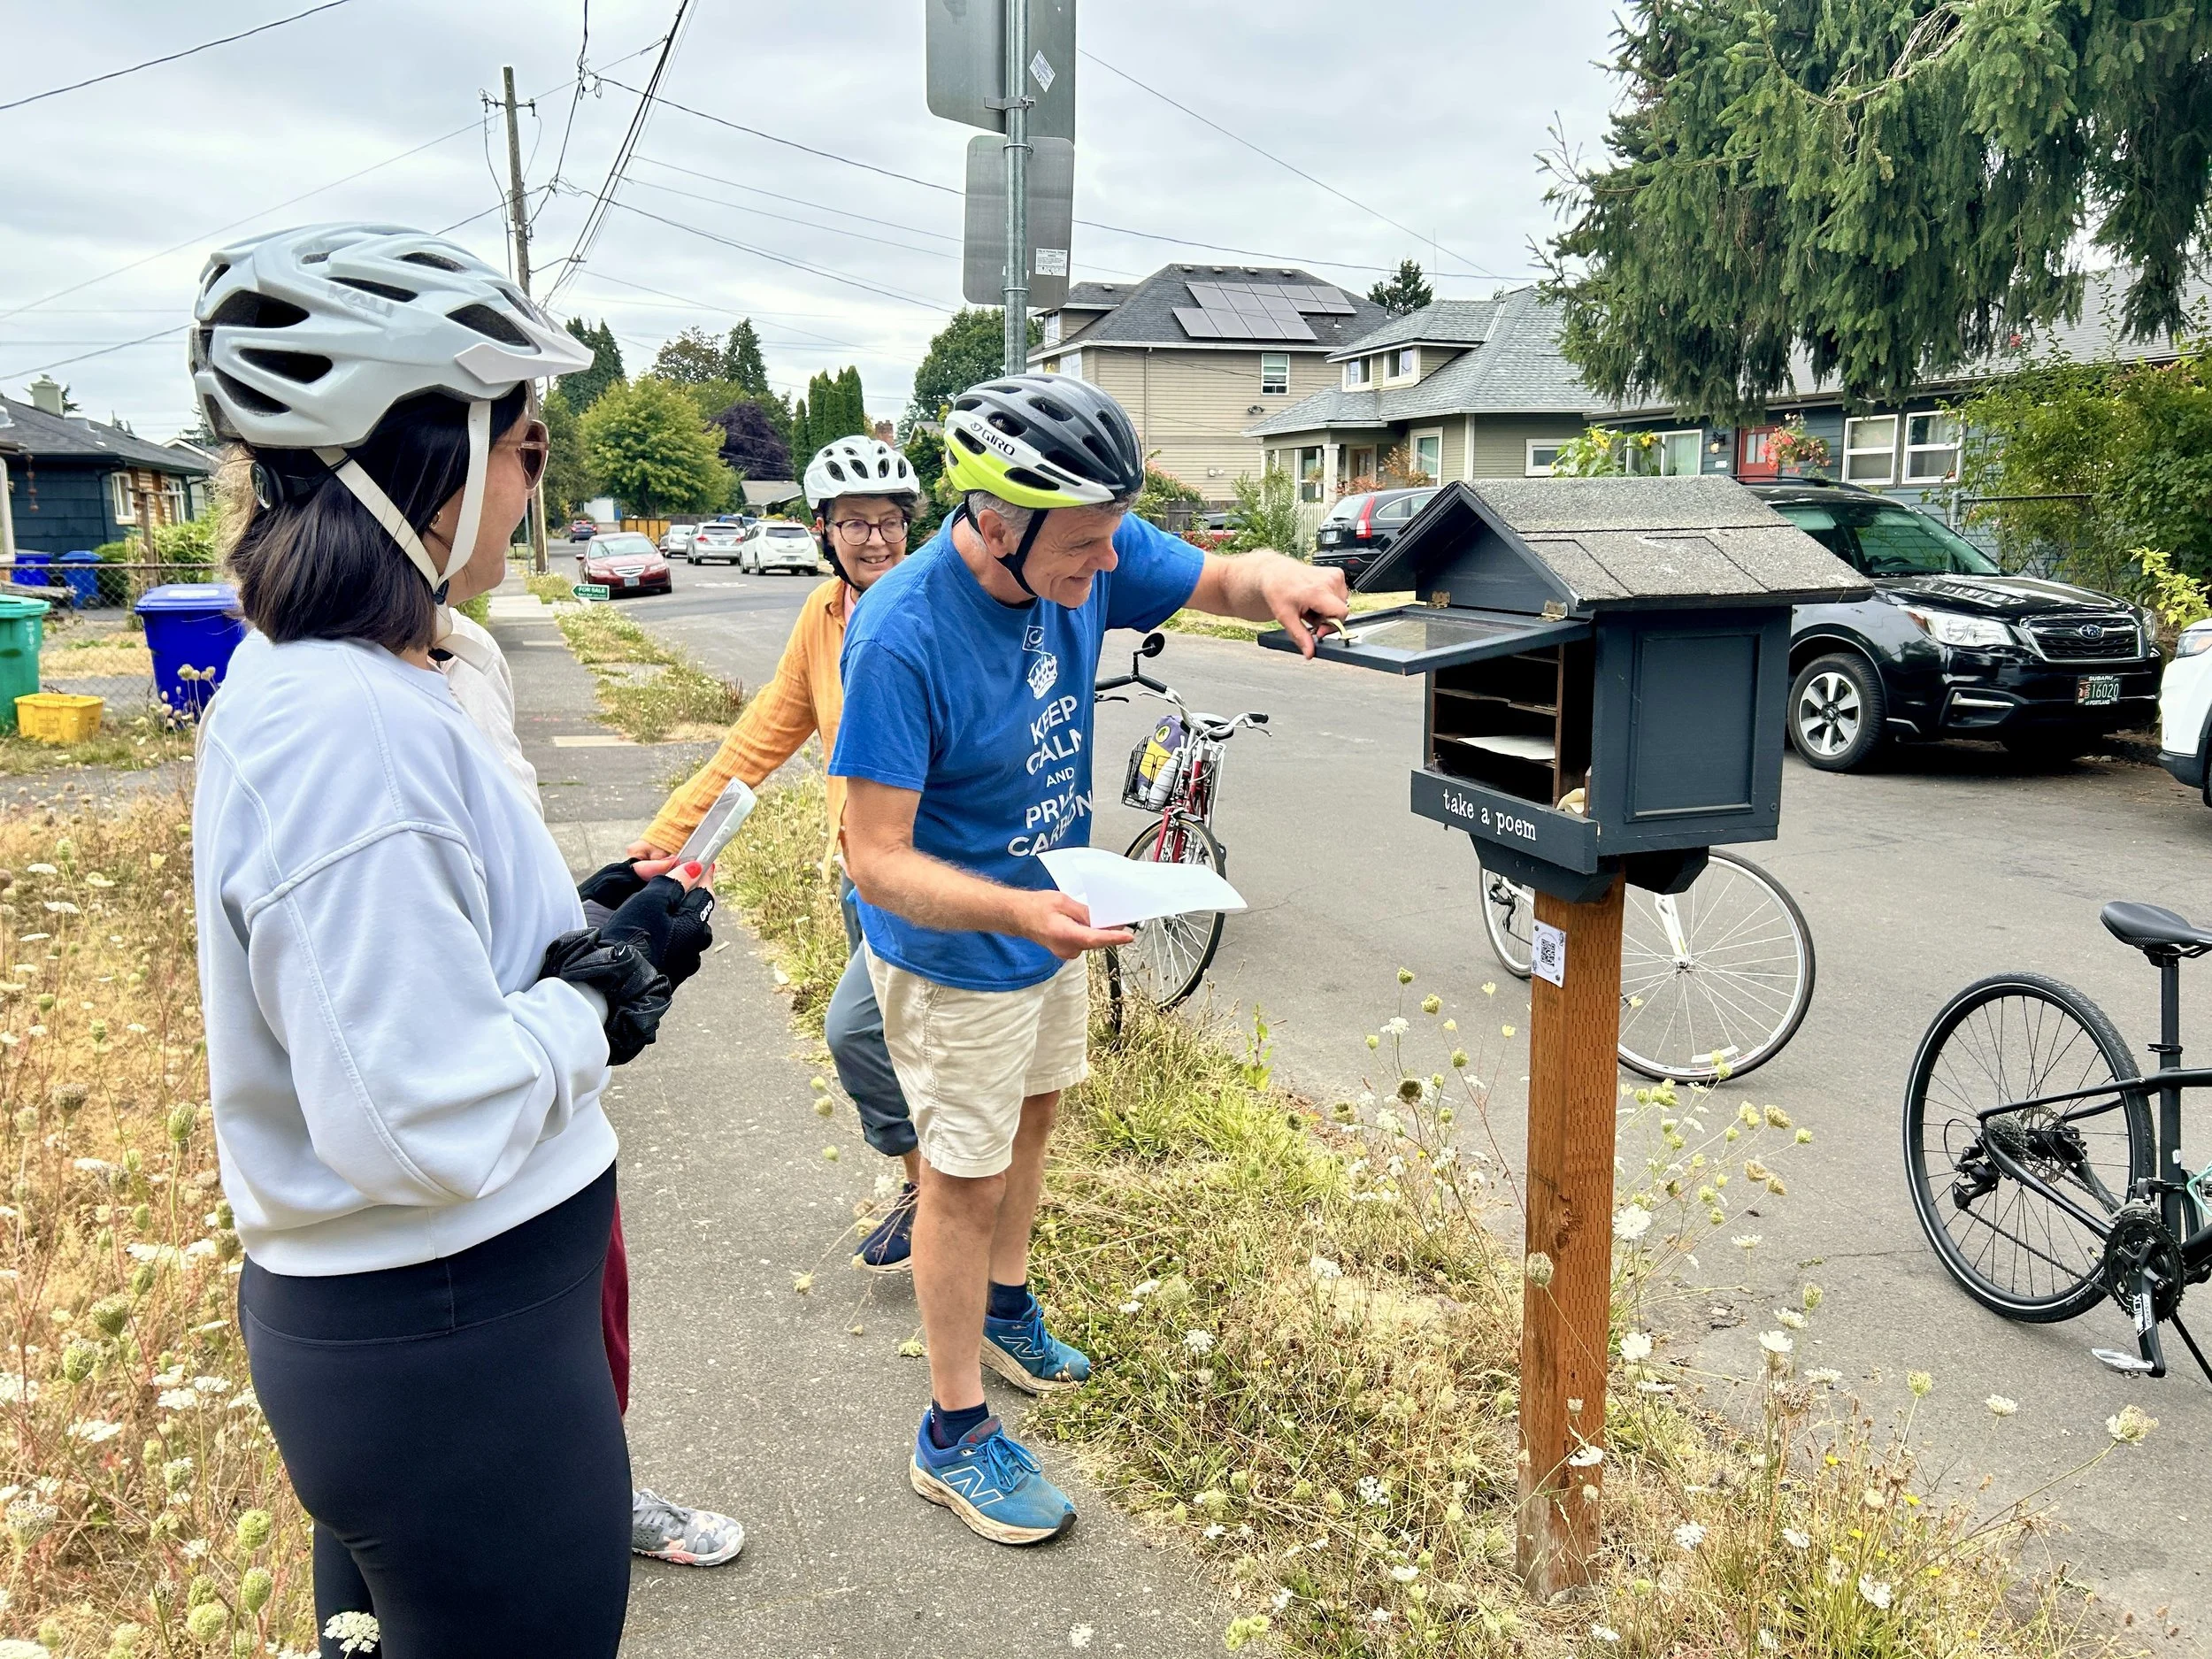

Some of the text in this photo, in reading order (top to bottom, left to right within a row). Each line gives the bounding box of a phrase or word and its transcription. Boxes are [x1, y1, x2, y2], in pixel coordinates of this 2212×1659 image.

[327, 284, 395, 318] KALI
[982, 429, 1015, 456] GIRO
[2092, 683, 2119, 698] 16020
[1030, 695, 1077, 745] KEEP
[1046, 766, 1075, 787] AND
[1007, 790, 1093, 856] CARBON
[1443, 788, 1536, 841] take a poem
